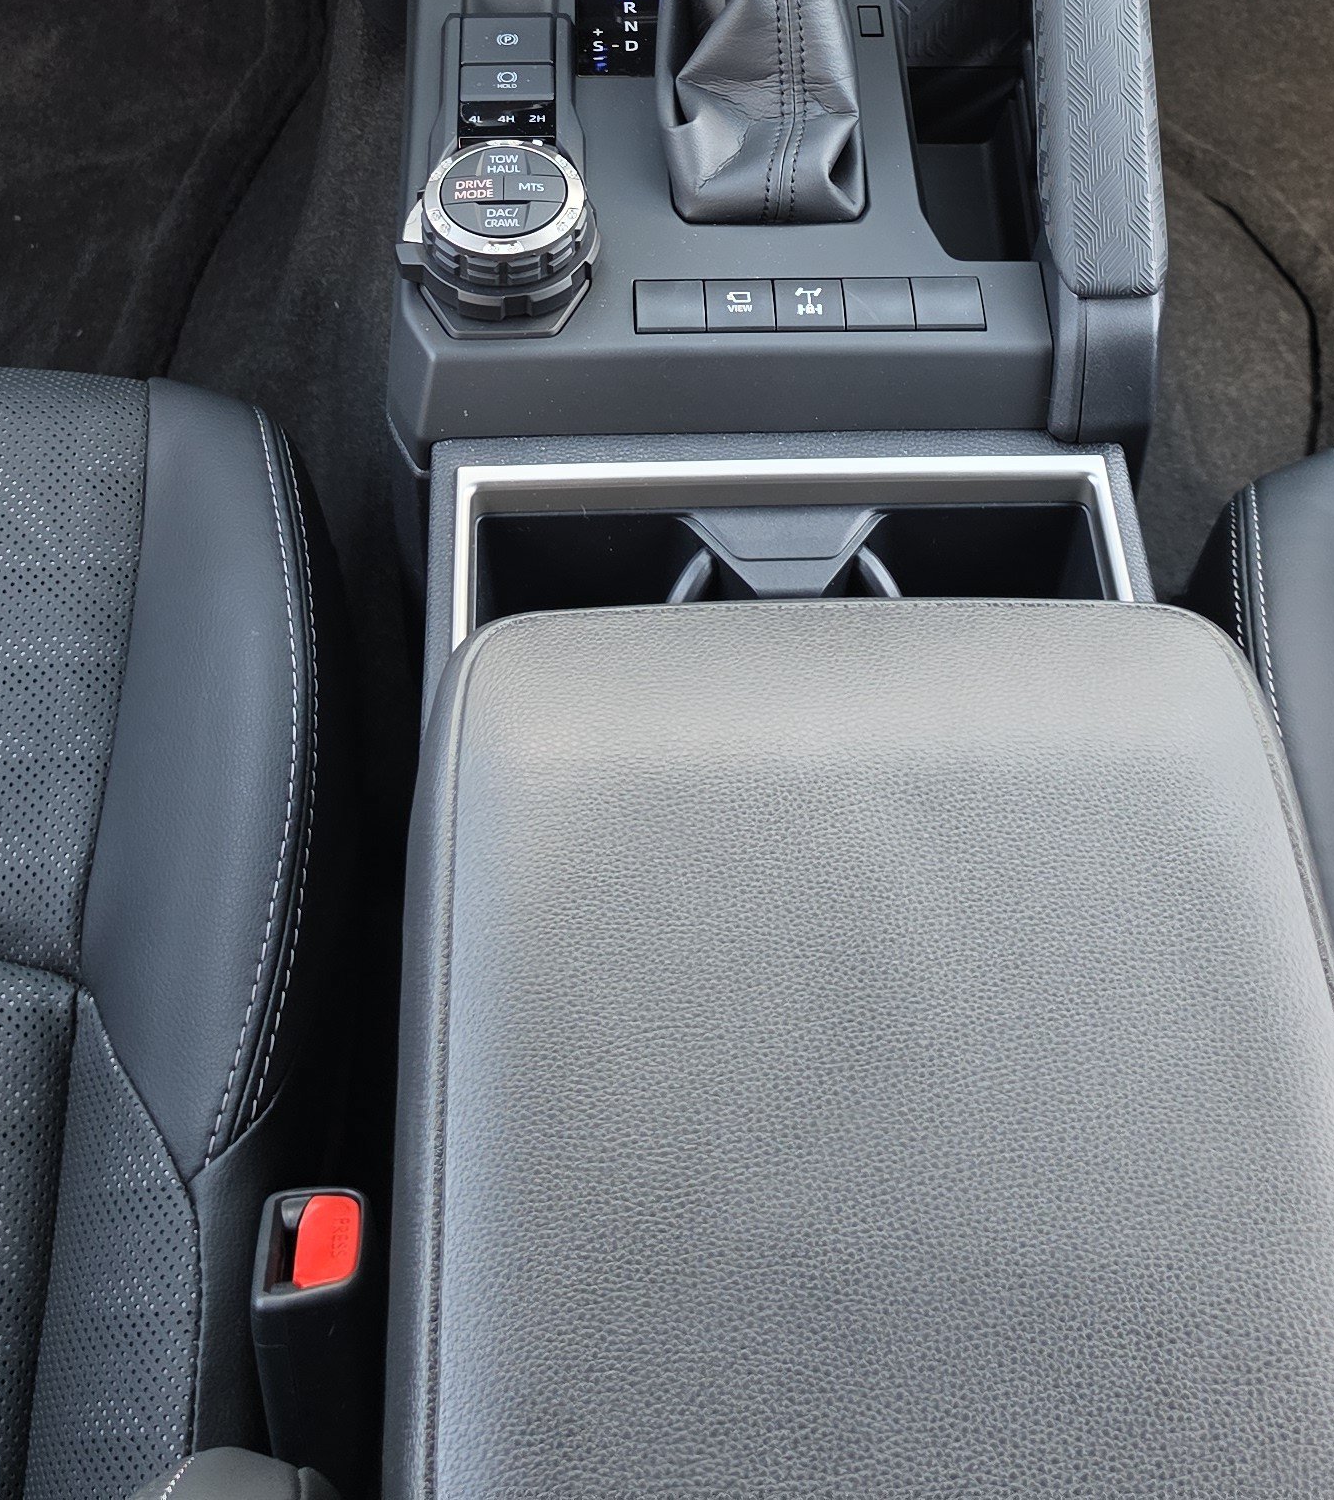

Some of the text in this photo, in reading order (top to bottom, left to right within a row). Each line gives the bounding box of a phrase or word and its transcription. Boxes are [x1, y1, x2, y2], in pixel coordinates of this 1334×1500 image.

[624, 2, 636, 13] R
[626, 21, 638, 32] N
[593, 40, 638, 51] S D
[497, 115, 515, 123] 4H
[529, 115, 545, 123] 2H
[489, 155, 518, 164] TOW
[487, 164, 521, 173] HAUL
[455, 179, 493, 189] DRIVE
[519, 182, 545, 192] MTS
[454, 189, 494, 199] MODE
[486, 208, 519, 218] DAC/
[484, 218, 520, 227] CRAWL
[727, 304, 753, 313] VIEW
[331, 1216, 351, 1259] PRESS
